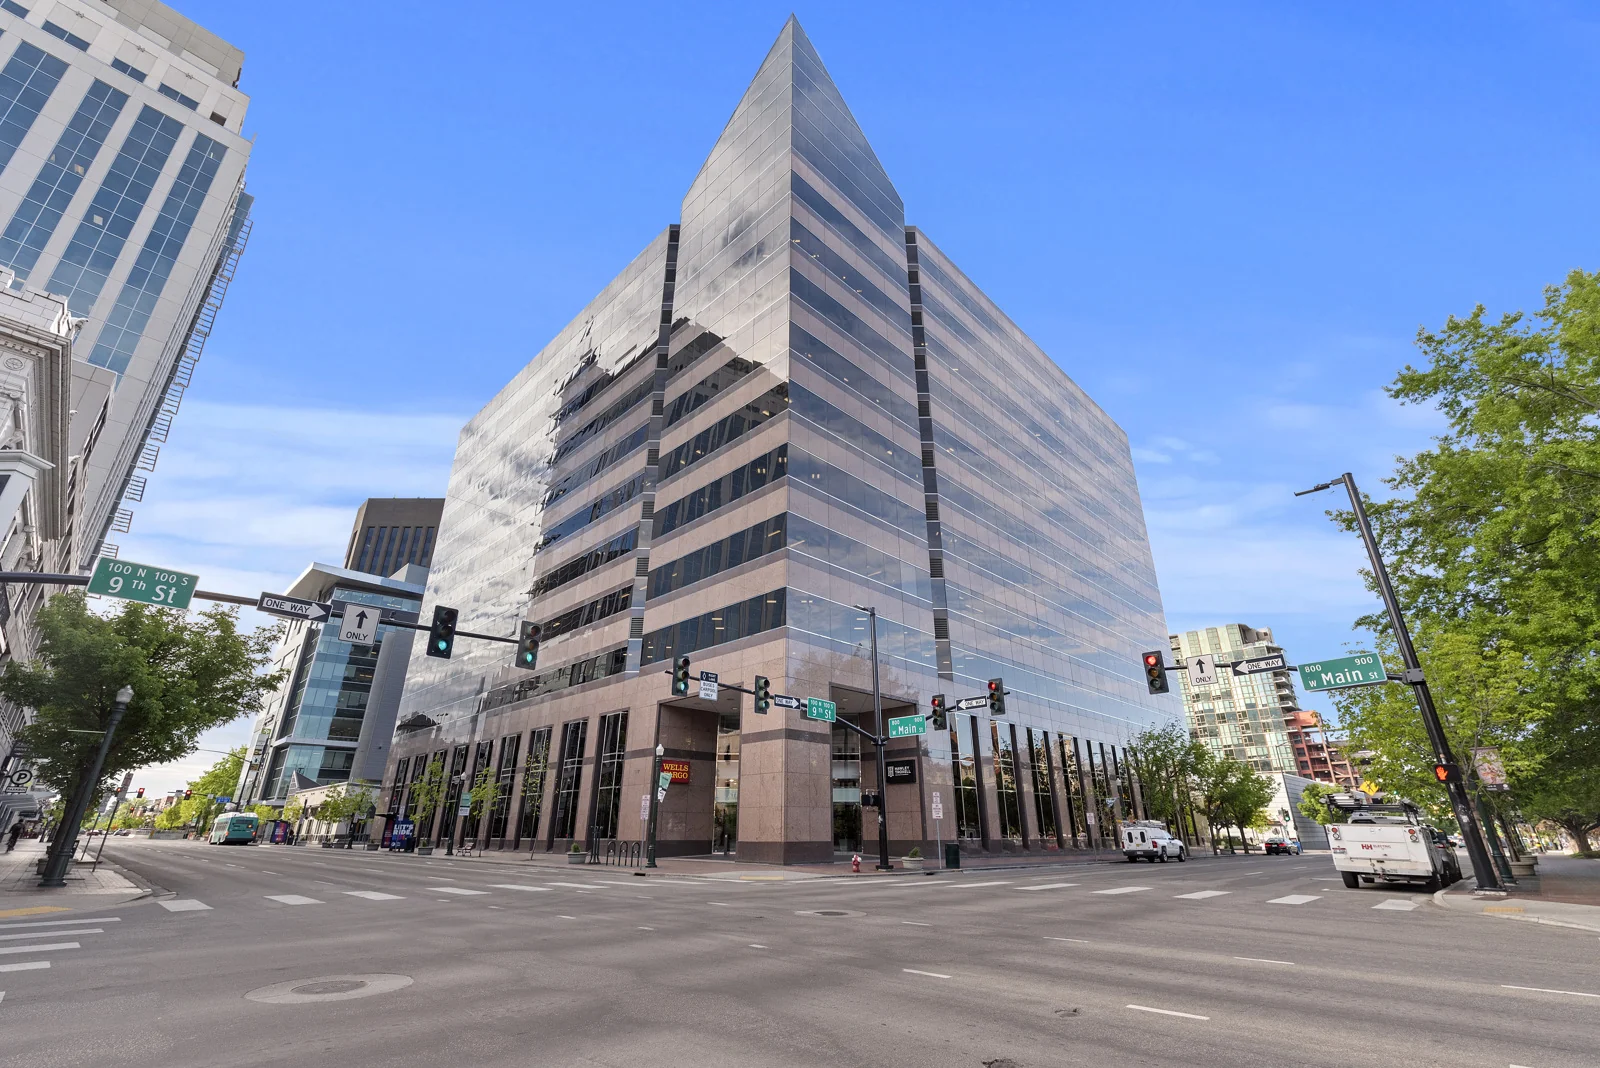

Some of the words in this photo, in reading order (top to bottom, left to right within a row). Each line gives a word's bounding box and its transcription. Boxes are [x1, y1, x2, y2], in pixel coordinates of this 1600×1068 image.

[108, 562, 132, 575] 100
[136, 568, 147, 577] N
[154, 571, 177, 584] 100
[180, 577, 189, 586] S
[107, 576, 124, 594] 9
[132, 580, 147, 591] Th
[151, 585, 177, 604] St
[265, 598, 286, 610] ONE
[290, 603, 311, 614] WAY
[345, 631, 369, 641] ONLY
[1247, 662, 1262, 671] ONE
[1264, 659, 1280, 667] WAY
[1304, 664, 1322, 673] 800
[1354, 656, 1373, 666] 900
[1195, 675, 1212, 684] ONLY
[1308, 679, 1317, 687] W
[1320, 668, 1363, 686] Main
[1368, 671, 1379, 680] St
[812, 706, 817, 717] 9
[824, 709, 832, 719] St
[898, 723, 917, 736] Main
[663, 763, 689, 772] WELLS
[16, 773, 27, 781] P
[664, 770, 689, 779] RGO
